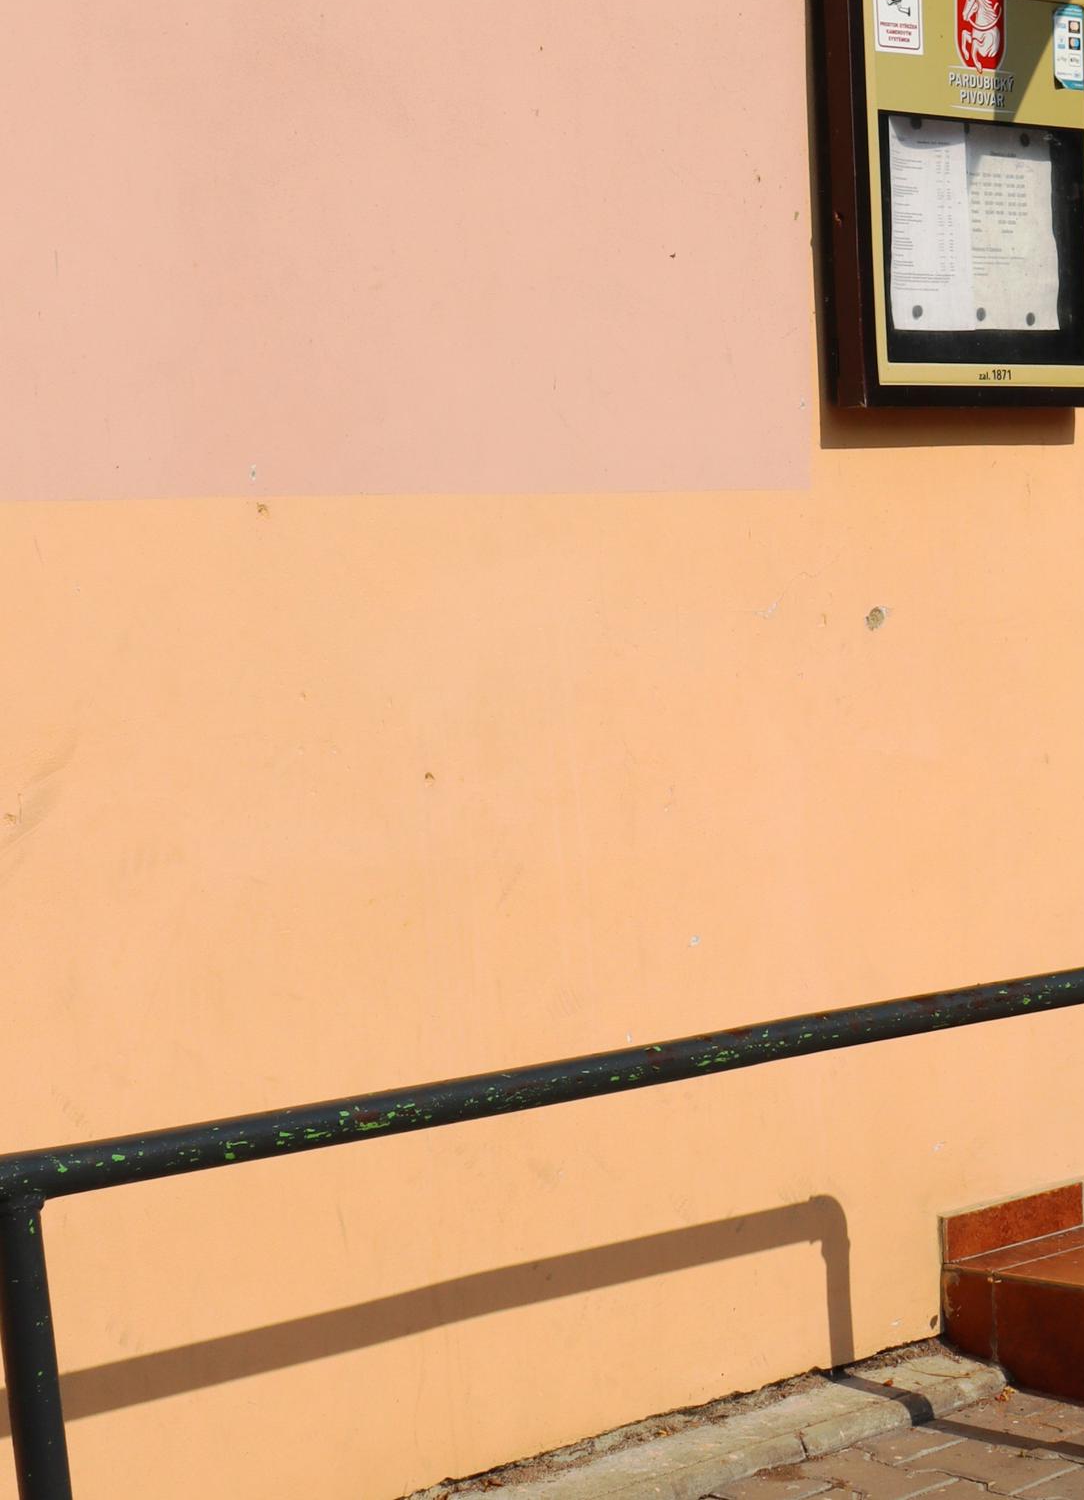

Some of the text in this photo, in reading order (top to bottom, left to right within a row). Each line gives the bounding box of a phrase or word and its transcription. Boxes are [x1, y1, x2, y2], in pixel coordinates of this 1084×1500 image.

[948, 71, 1016, 93] PARDUBICKÝ
[960, 89, 1005, 108] PIVOVAR
[992, 369, 1012, 381] 1871
